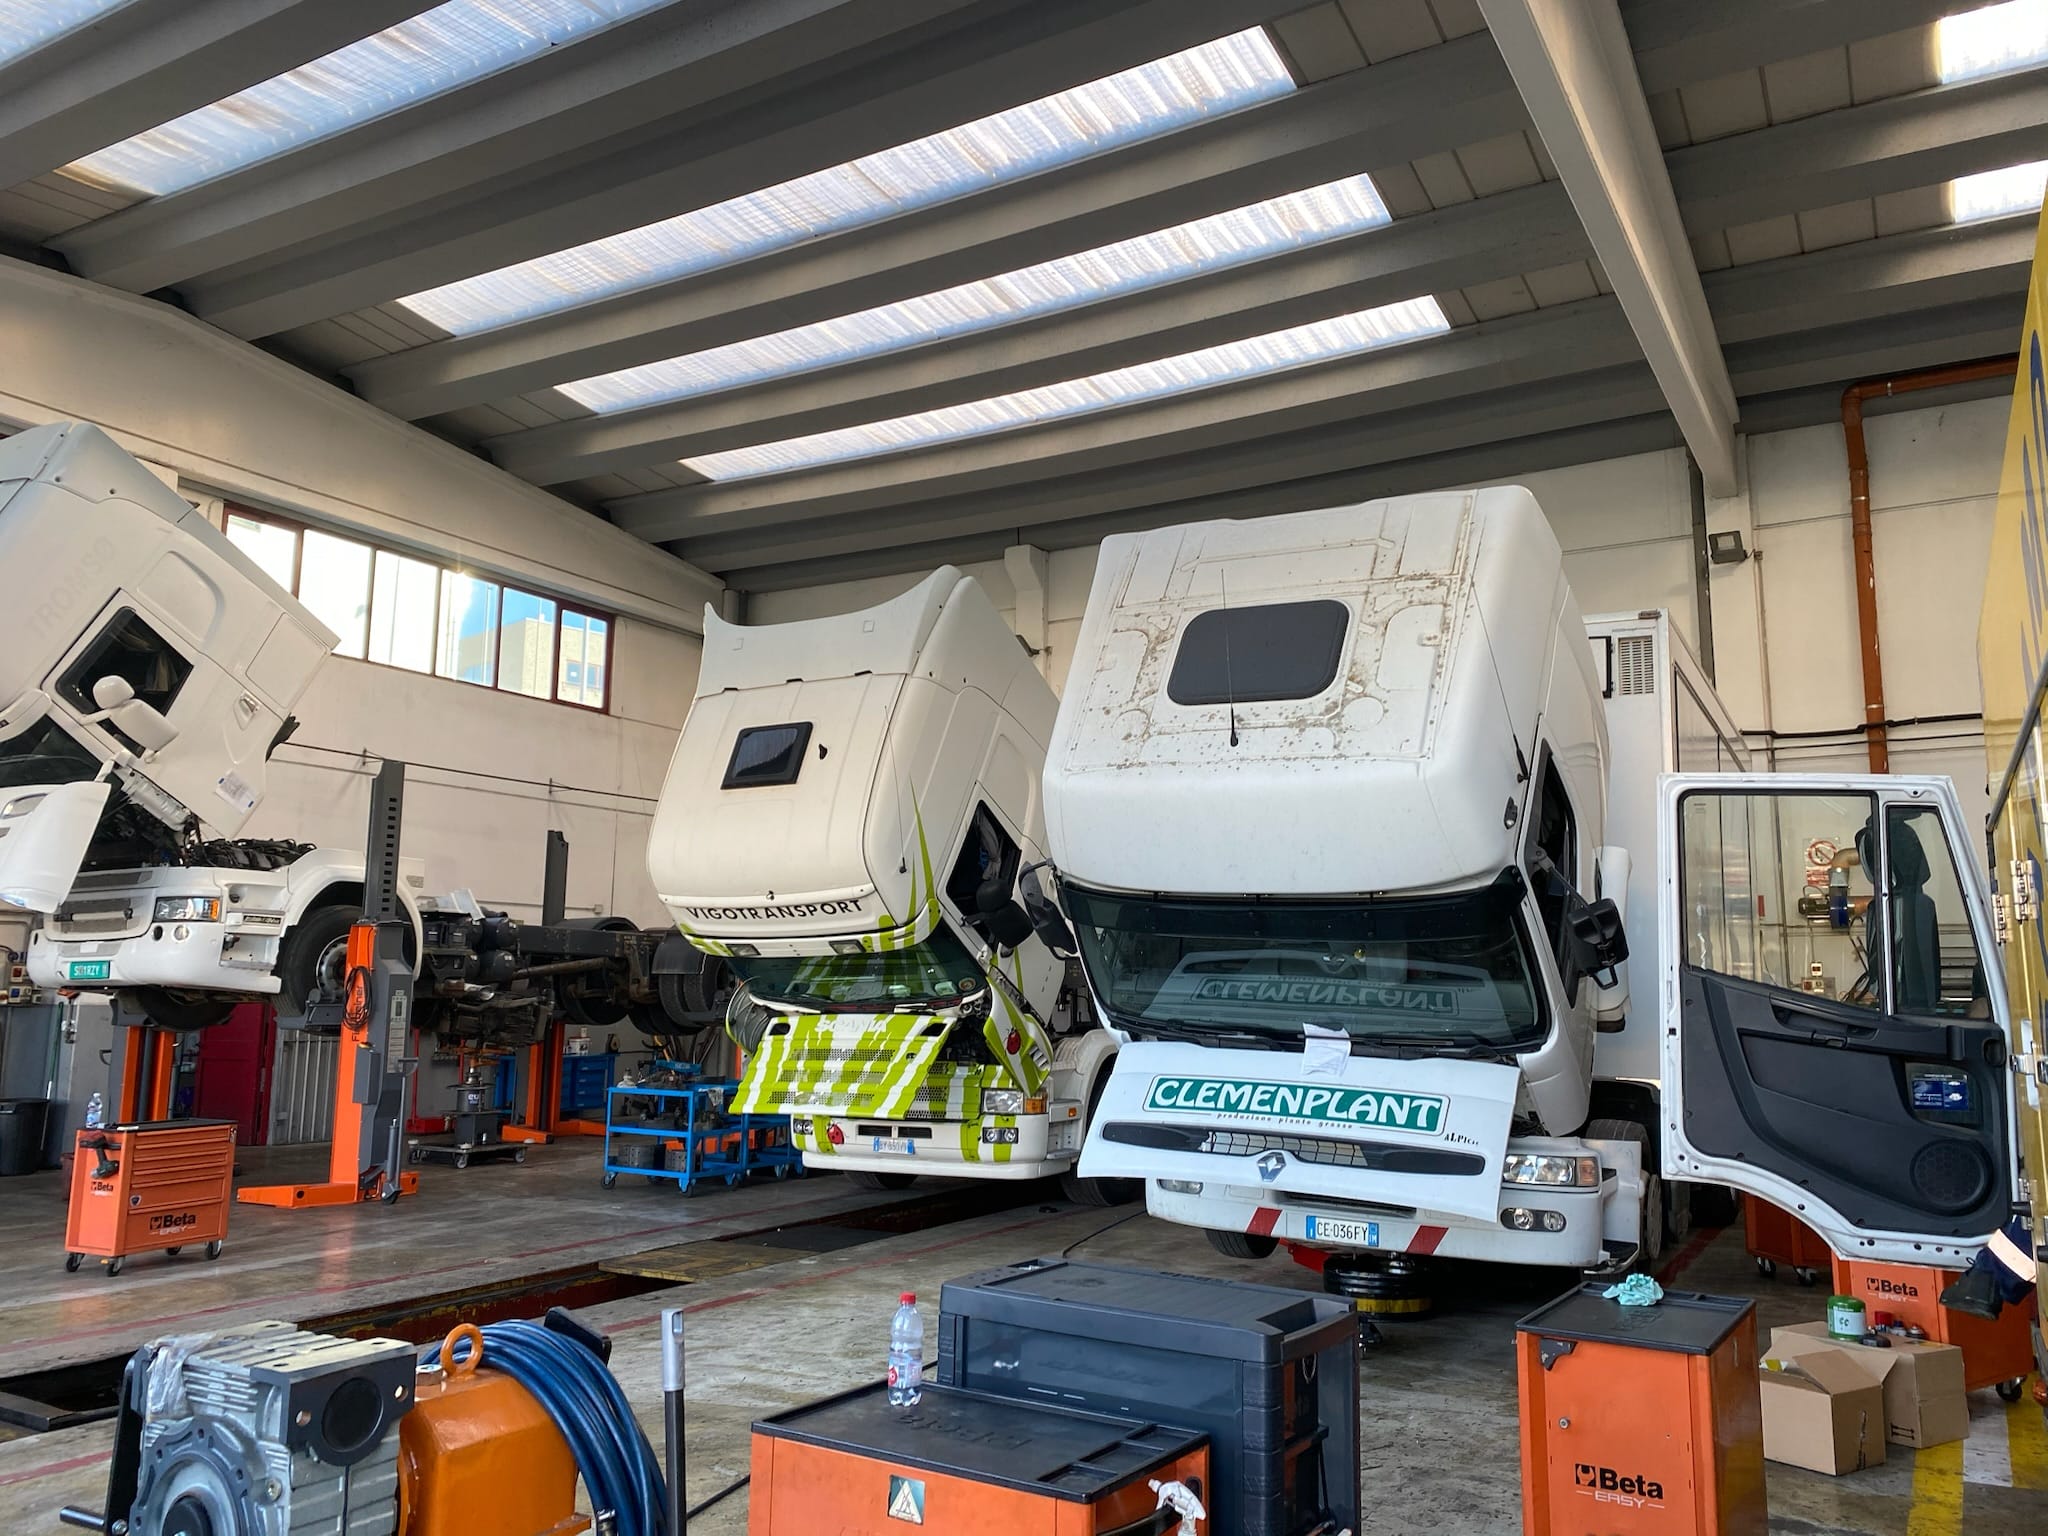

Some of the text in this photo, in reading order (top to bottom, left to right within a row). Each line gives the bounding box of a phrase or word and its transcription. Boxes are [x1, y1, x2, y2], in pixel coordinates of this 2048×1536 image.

[686, 899, 863, 920] VIGOTRANSPORT
[1154, 1079, 1441, 1129] CLEMENPLANT
[1278, 1117, 1311, 1125] piante
[1318, 1121, 1353, 1129] grasse
[97, 1181, 114, 1192] Beta
[163, 1212, 196, 1229] Beta
[1881, 1279, 1918, 1297] Beta
[1600, 1467, 1664, 1500] Beta
[1594, 1490, 1646, 1509] EASY
